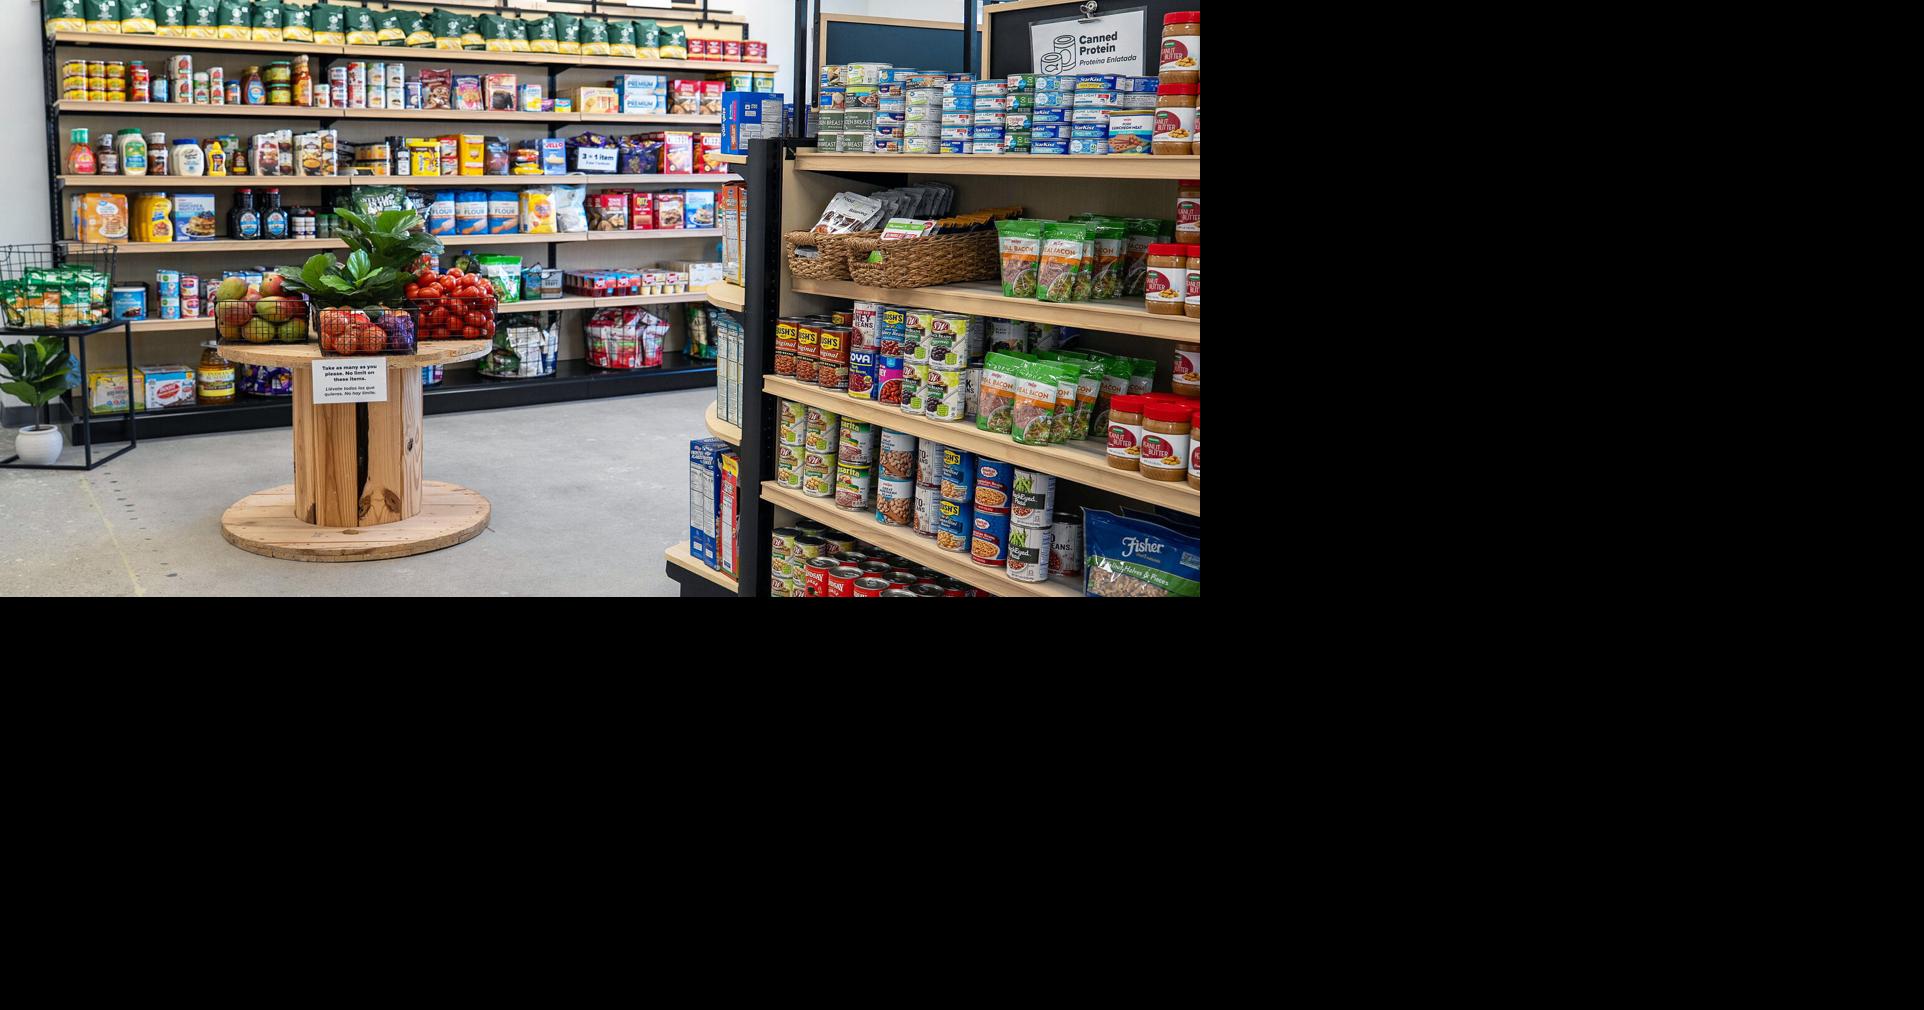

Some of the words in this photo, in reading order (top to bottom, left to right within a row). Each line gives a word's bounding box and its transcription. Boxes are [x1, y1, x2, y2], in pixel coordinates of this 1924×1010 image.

[1079, 31, 1118, 44] Canned
[1079, 43, 1116, 55] Protein
[1106, 54, 1137, 64] Enlatada
[599, 153, 614, 161] item
[1148, 448, 1169, 457] BUTTER
[1121, 536, 1165, 557] Fisher
[1150, 573, 1169, 586] Pieces
